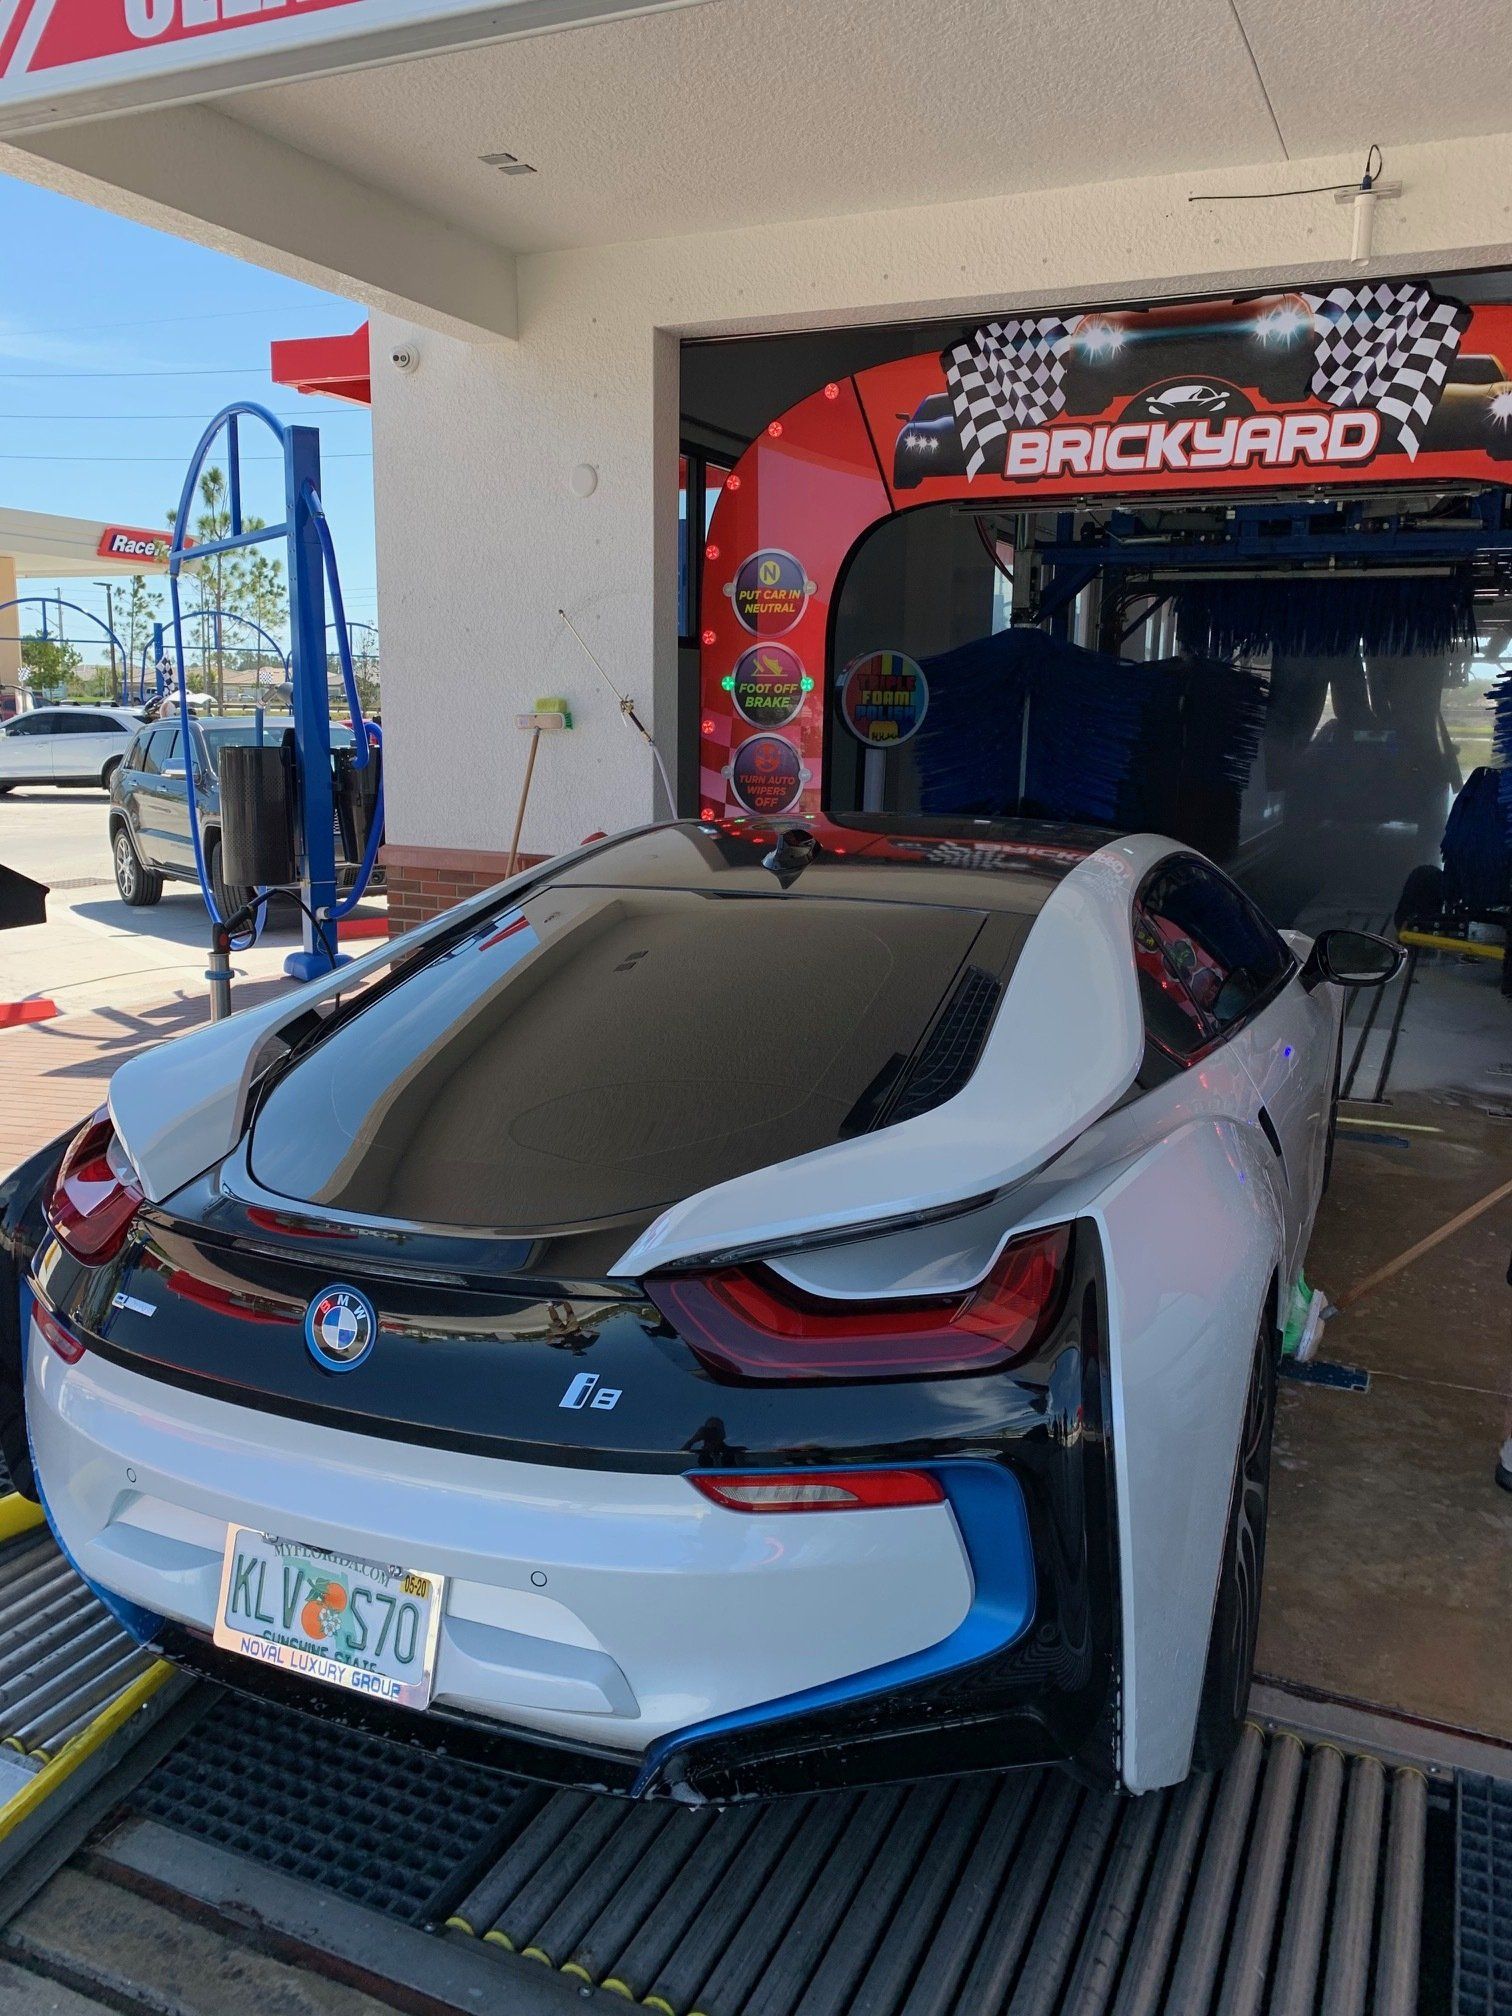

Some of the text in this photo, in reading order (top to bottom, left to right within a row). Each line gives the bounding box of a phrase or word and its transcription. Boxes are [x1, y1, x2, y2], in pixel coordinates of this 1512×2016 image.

[1005, 412, 1379, 476] BRICKYARD
[112, 534, 186, 557] RaceT
[763, 564, 777, 581] N
[739, 589, 801, 600] PUT CAR IN
[744, 603, 796, 614] NEUTRAL
[739, 683, 799, 693] FOOT OFF
[745, 696, 791, 708] BRAKE
[862, 690, 910, 706] FOAM
[740, 775, 796, 785] TURN AUTO
[747, 785, 787, 796] WIPERS
[755, 797, 779, 808] OFF
[319, 1294, 367, 1321] BMW
[558, 1372, 623, 1410] i8
[404, 1575, 427, 1598] 05-20
[231, 1554, 420, 1664] KLV S70
[240, 1637, 401, 1699] NOVAL LUXURY GROUP
